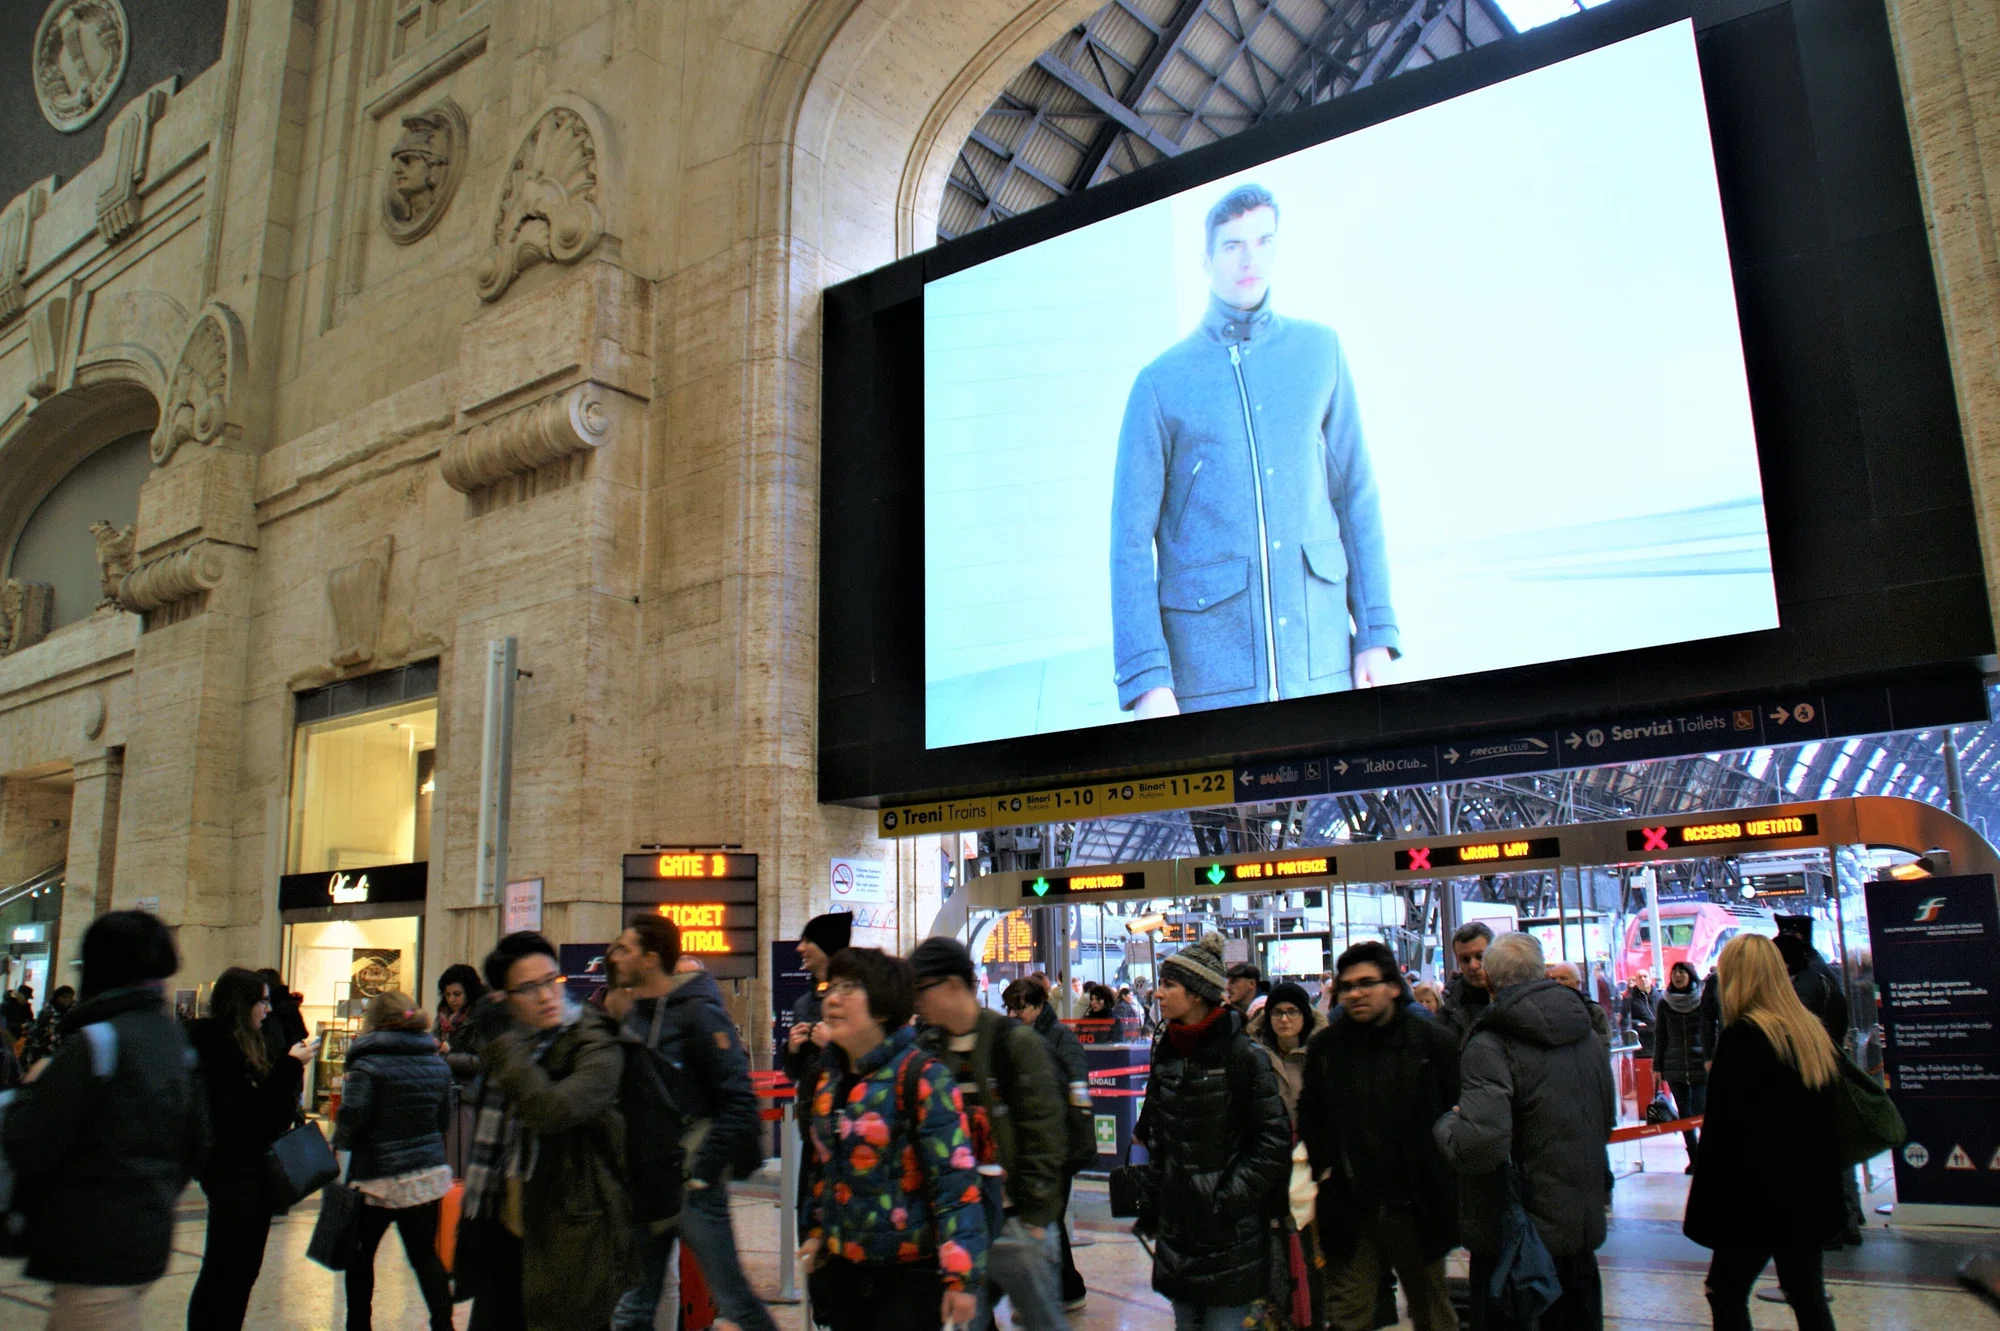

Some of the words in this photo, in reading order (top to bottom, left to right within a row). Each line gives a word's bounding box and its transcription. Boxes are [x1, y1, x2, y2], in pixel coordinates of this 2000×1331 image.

[1611, 721, 1673, 742] Servizi
[1678, 716, 1726, 731] Toilets
[1396, 758, 1420, 770] Club
[1138, 781, 1166, 792] Binari
[1170, 774, 1226, 796] 11-22
[1026, 793, 1051, 804] Binari
[1055, 789, 1094, 808] 1-10
[903, 805, 943, 825] Treni
[947, 803, 987, 820] Trains
[1683, 823, 1741, 842] ACCESSO
[1745, 818, 1802, 836] VIETATO
[1460, 844, 1499, 861] WRONG
[1504, 842, 1529, 858] WAY
[659, 855, 705, 877] GATE
[1236, 864, 1262, 879] GATE
[1277, 859, 1328, 876] PARTENZE
[1069, 874, 1124, 891] DEPARTURES
[658, 905, 725, 927] TICKET
[1897, 990, 1930, 999] biglietto
[1931, 990, 1945, 998] per
[1931, 981, 1971, 990] preparare
[1917, 1023, 1933, 1031] have
[1949, 1022, 1970, 1030] tickets
